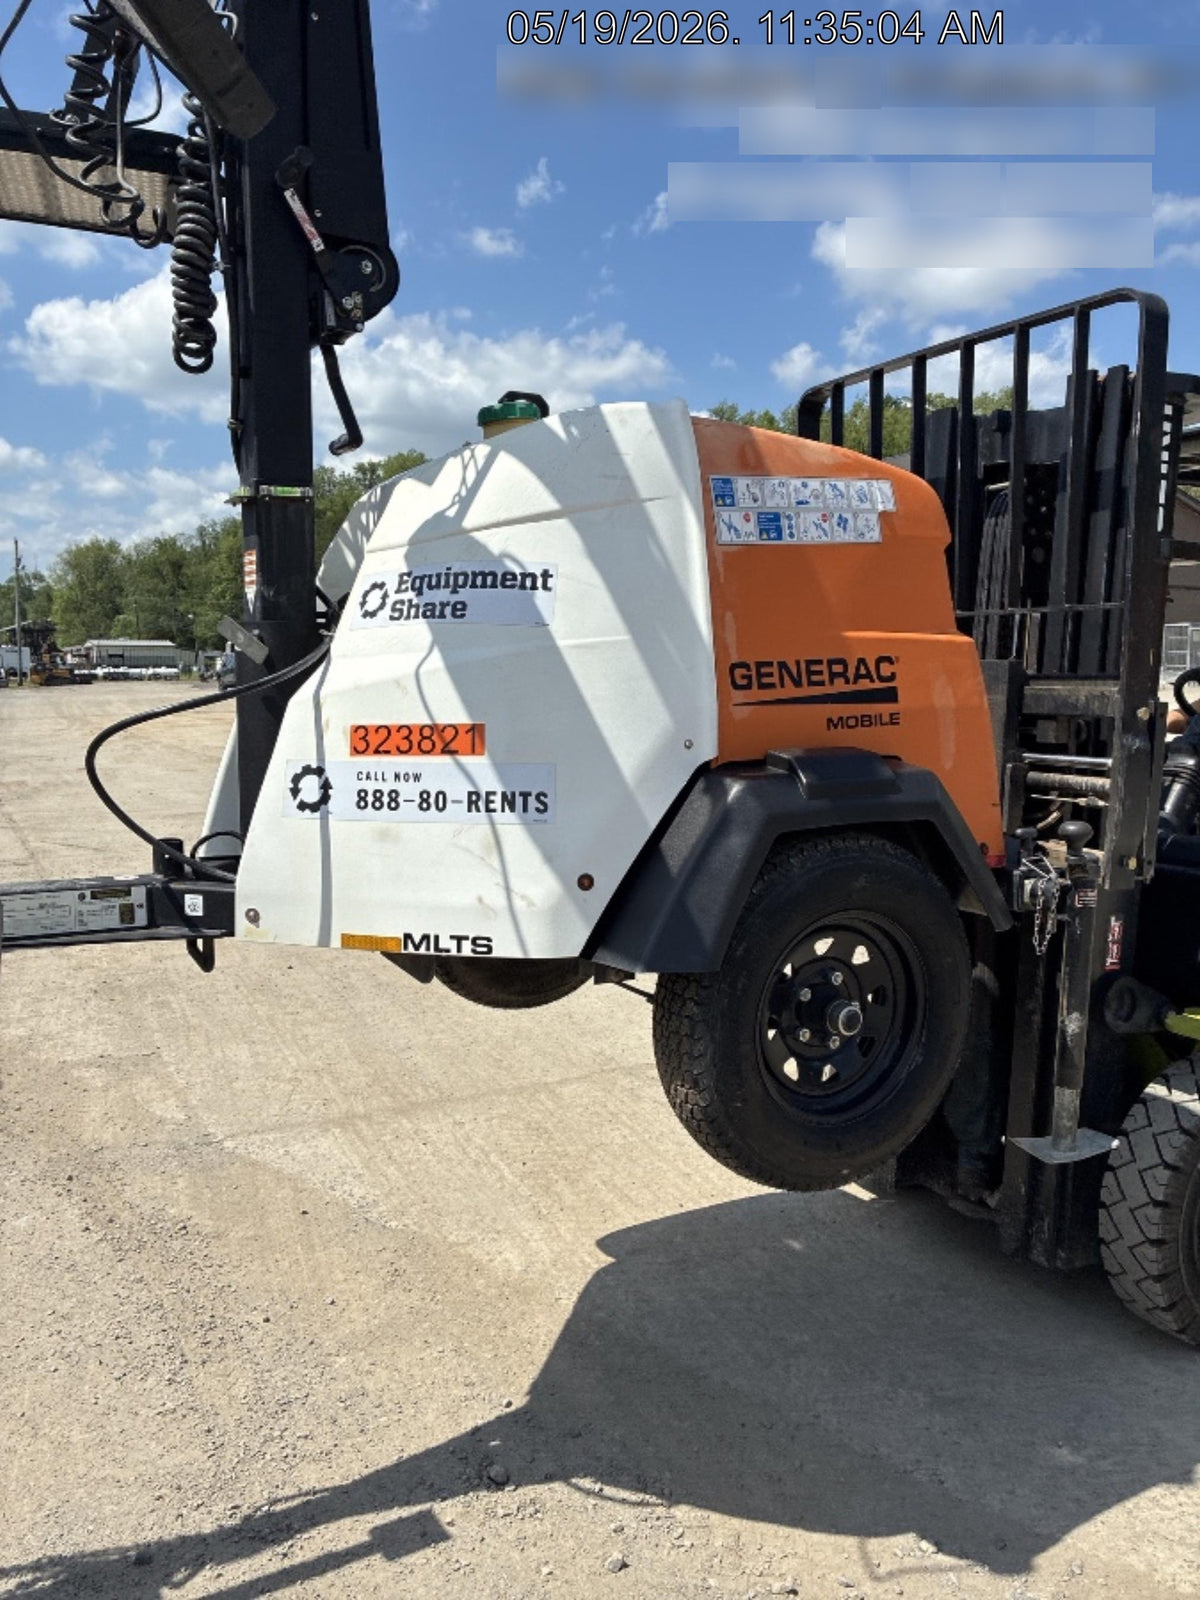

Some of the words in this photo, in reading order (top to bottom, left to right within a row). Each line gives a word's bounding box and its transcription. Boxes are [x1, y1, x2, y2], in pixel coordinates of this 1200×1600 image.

[394, 567, 554, 597] Equipment
[388, 599, 468, 621] Share
[729, 655, 897, 691] GENERAC
[826, 712, 901, 732] MOBILE
[353, 725, 478, 755] 323821
[356, 771, 387, 782] CALL
[393, 772, 423, 783] NOW
[355, 788, 550, 815] 888-80-RENTS
[402, 932, 494, 956] MLTS
